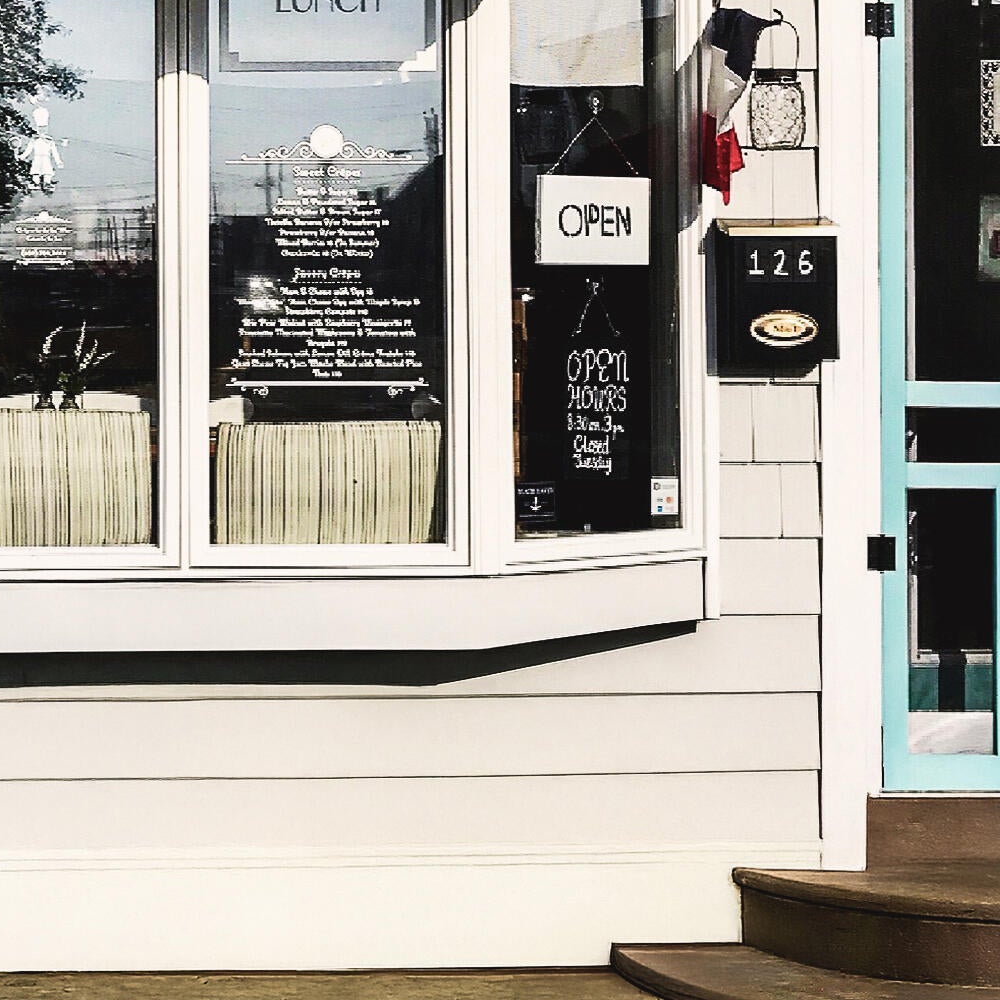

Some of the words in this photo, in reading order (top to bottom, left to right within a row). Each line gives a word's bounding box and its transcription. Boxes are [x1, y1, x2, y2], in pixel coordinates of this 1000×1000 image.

[558, 203, 632, 238] OPEN
[749, 249, 815, 276] 126
[567, 348, 630, 382] OPEN
[567, 384, 627, 412] HOURS
